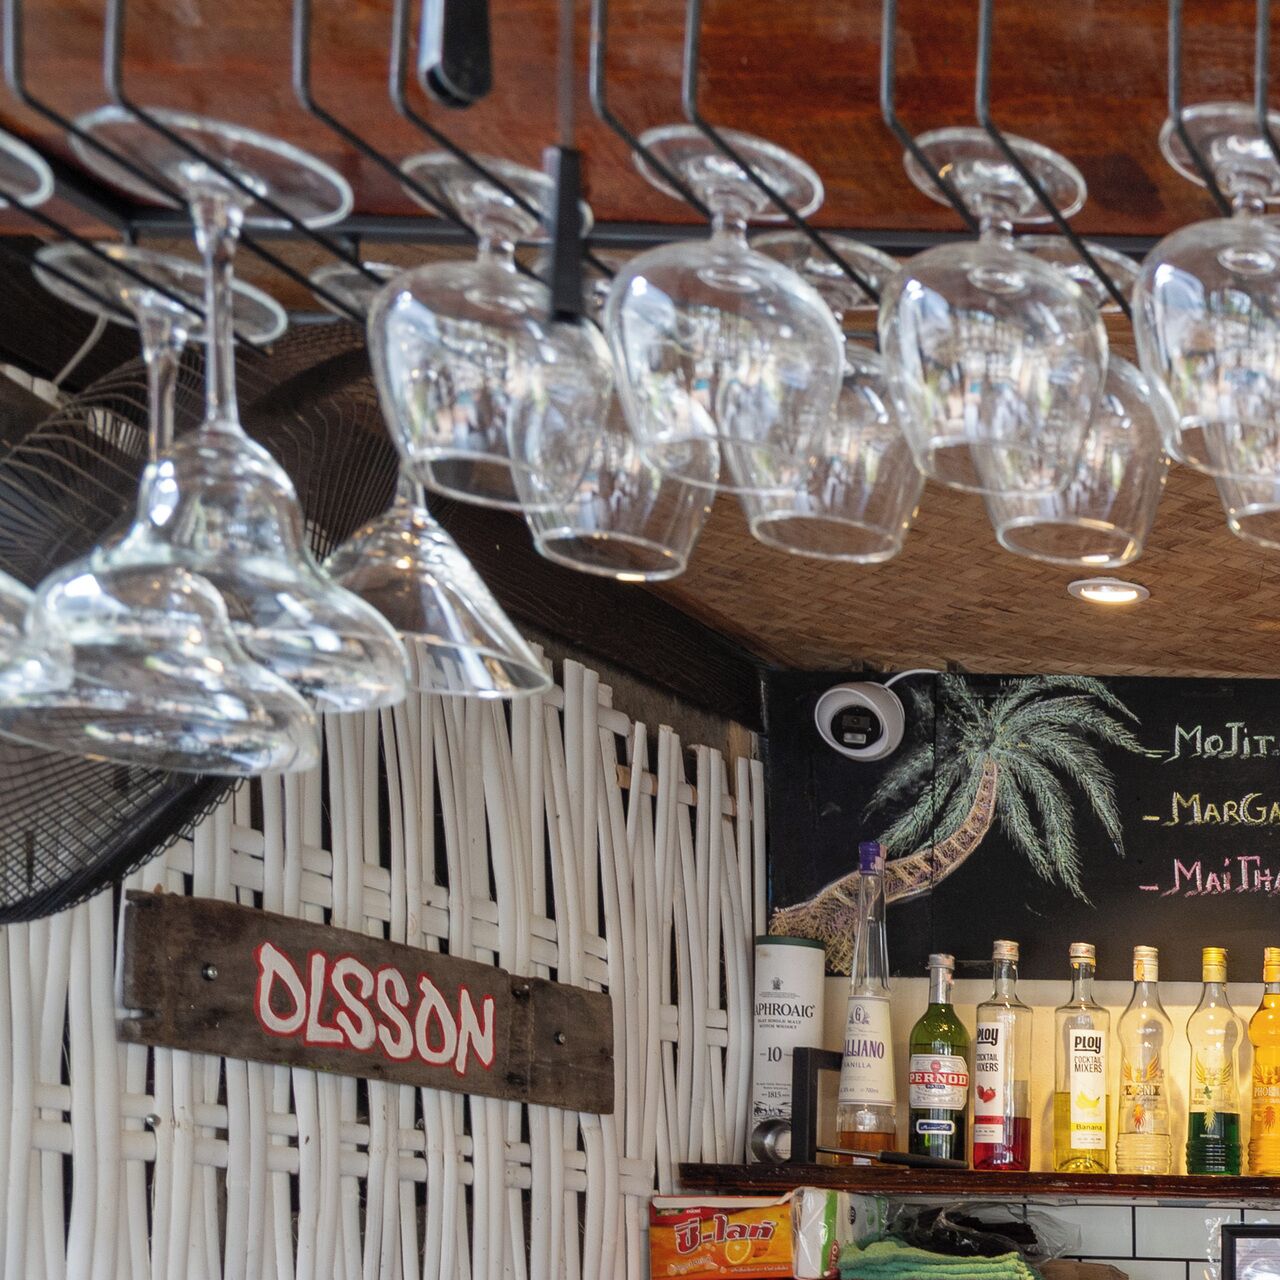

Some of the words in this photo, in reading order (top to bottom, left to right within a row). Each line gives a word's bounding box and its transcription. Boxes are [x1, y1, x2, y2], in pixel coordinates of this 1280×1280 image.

[253, 939, 497, 1077] OLSSON
[844, 1040, 885, 1059] LLIANO
[1074, 1036, 1102, 1053] PLOY
[767, 1047, 782, 1062] 10
[1074, 1056, 1102, 1064] COCKTAIL
[1074, 1064, 1103, 1073] MIXERS
[910, 1072, 968, 1086] PERNOD
